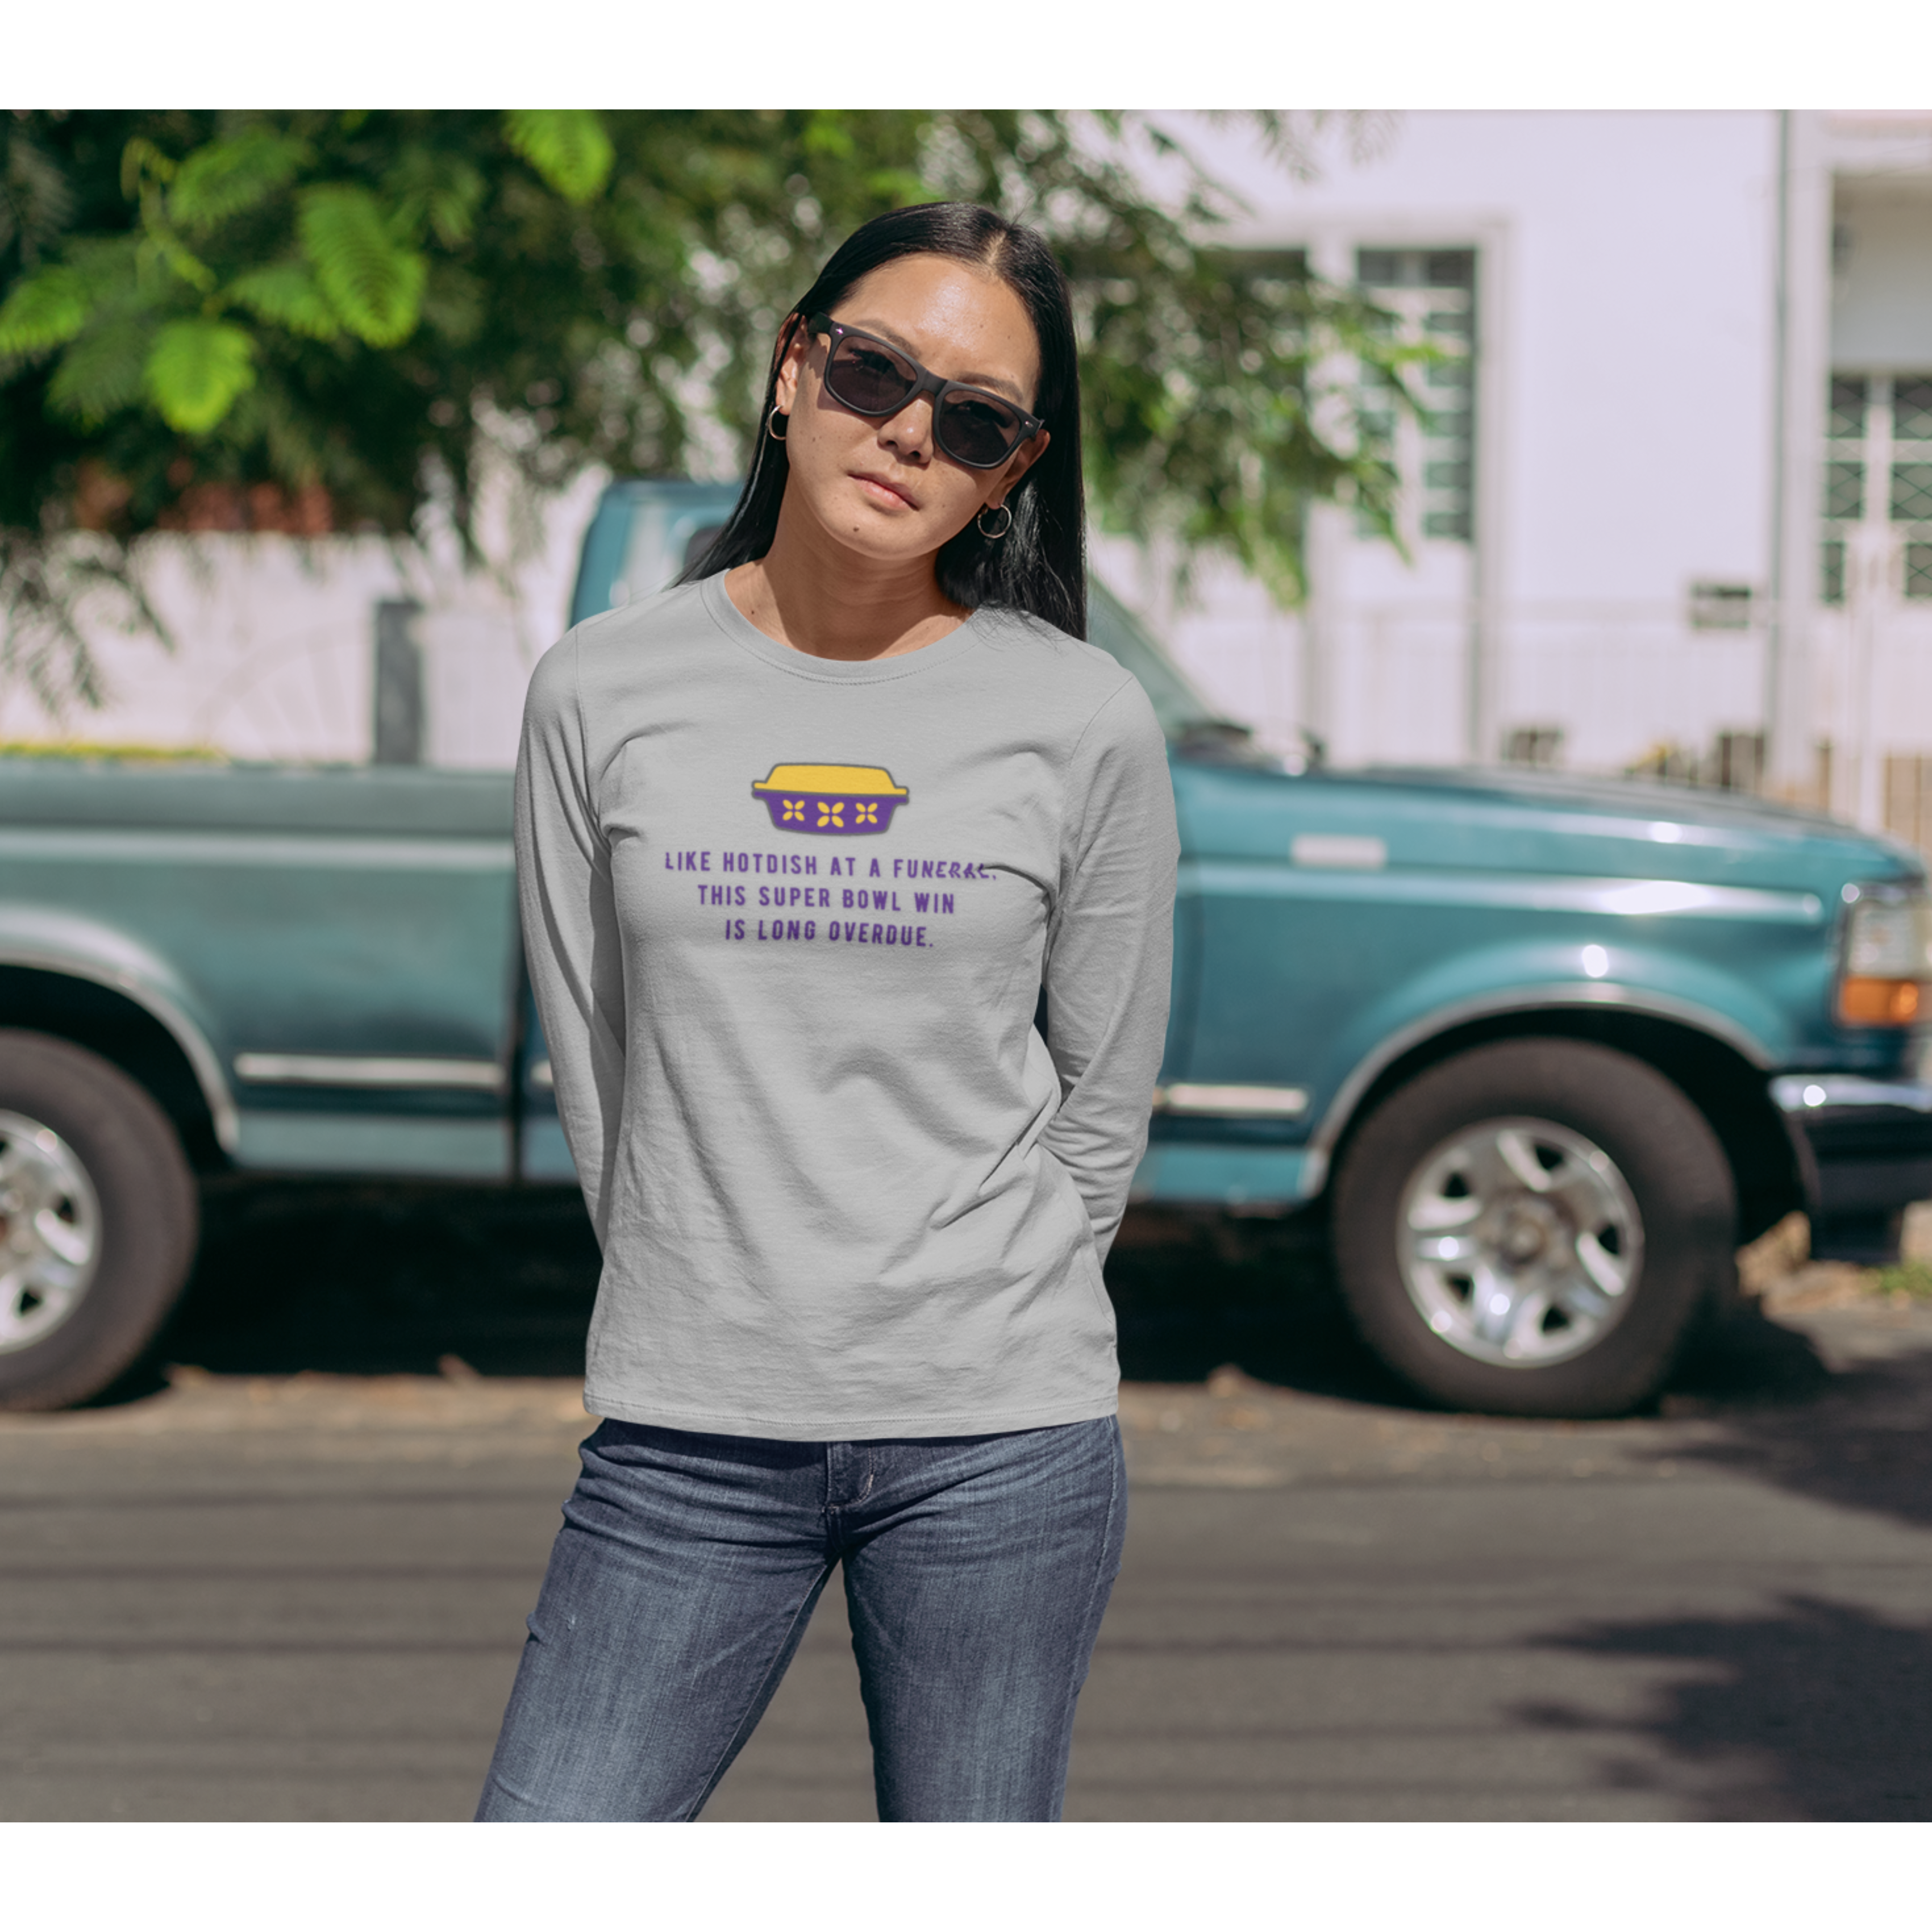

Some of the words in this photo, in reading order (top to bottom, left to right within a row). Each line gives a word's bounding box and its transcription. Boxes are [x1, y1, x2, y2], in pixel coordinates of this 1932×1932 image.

[665, 851, 711, 872] LIKE
[723, 852, 817, 875] HOTDISH
[830, 856, 856, 877] AT
[869, 857, 881, 878] A
[697, 884, 746, 906] THIS
[758, 886, 830, 908] SUPER
[841, 889, 901, 911] BOWL
[914, 892, 954, 914] WIN
[725, 919, 745, 940] IS
[758, 919, 816, 940] LONG
[828, 921, 933, 947] OVERDUE.
